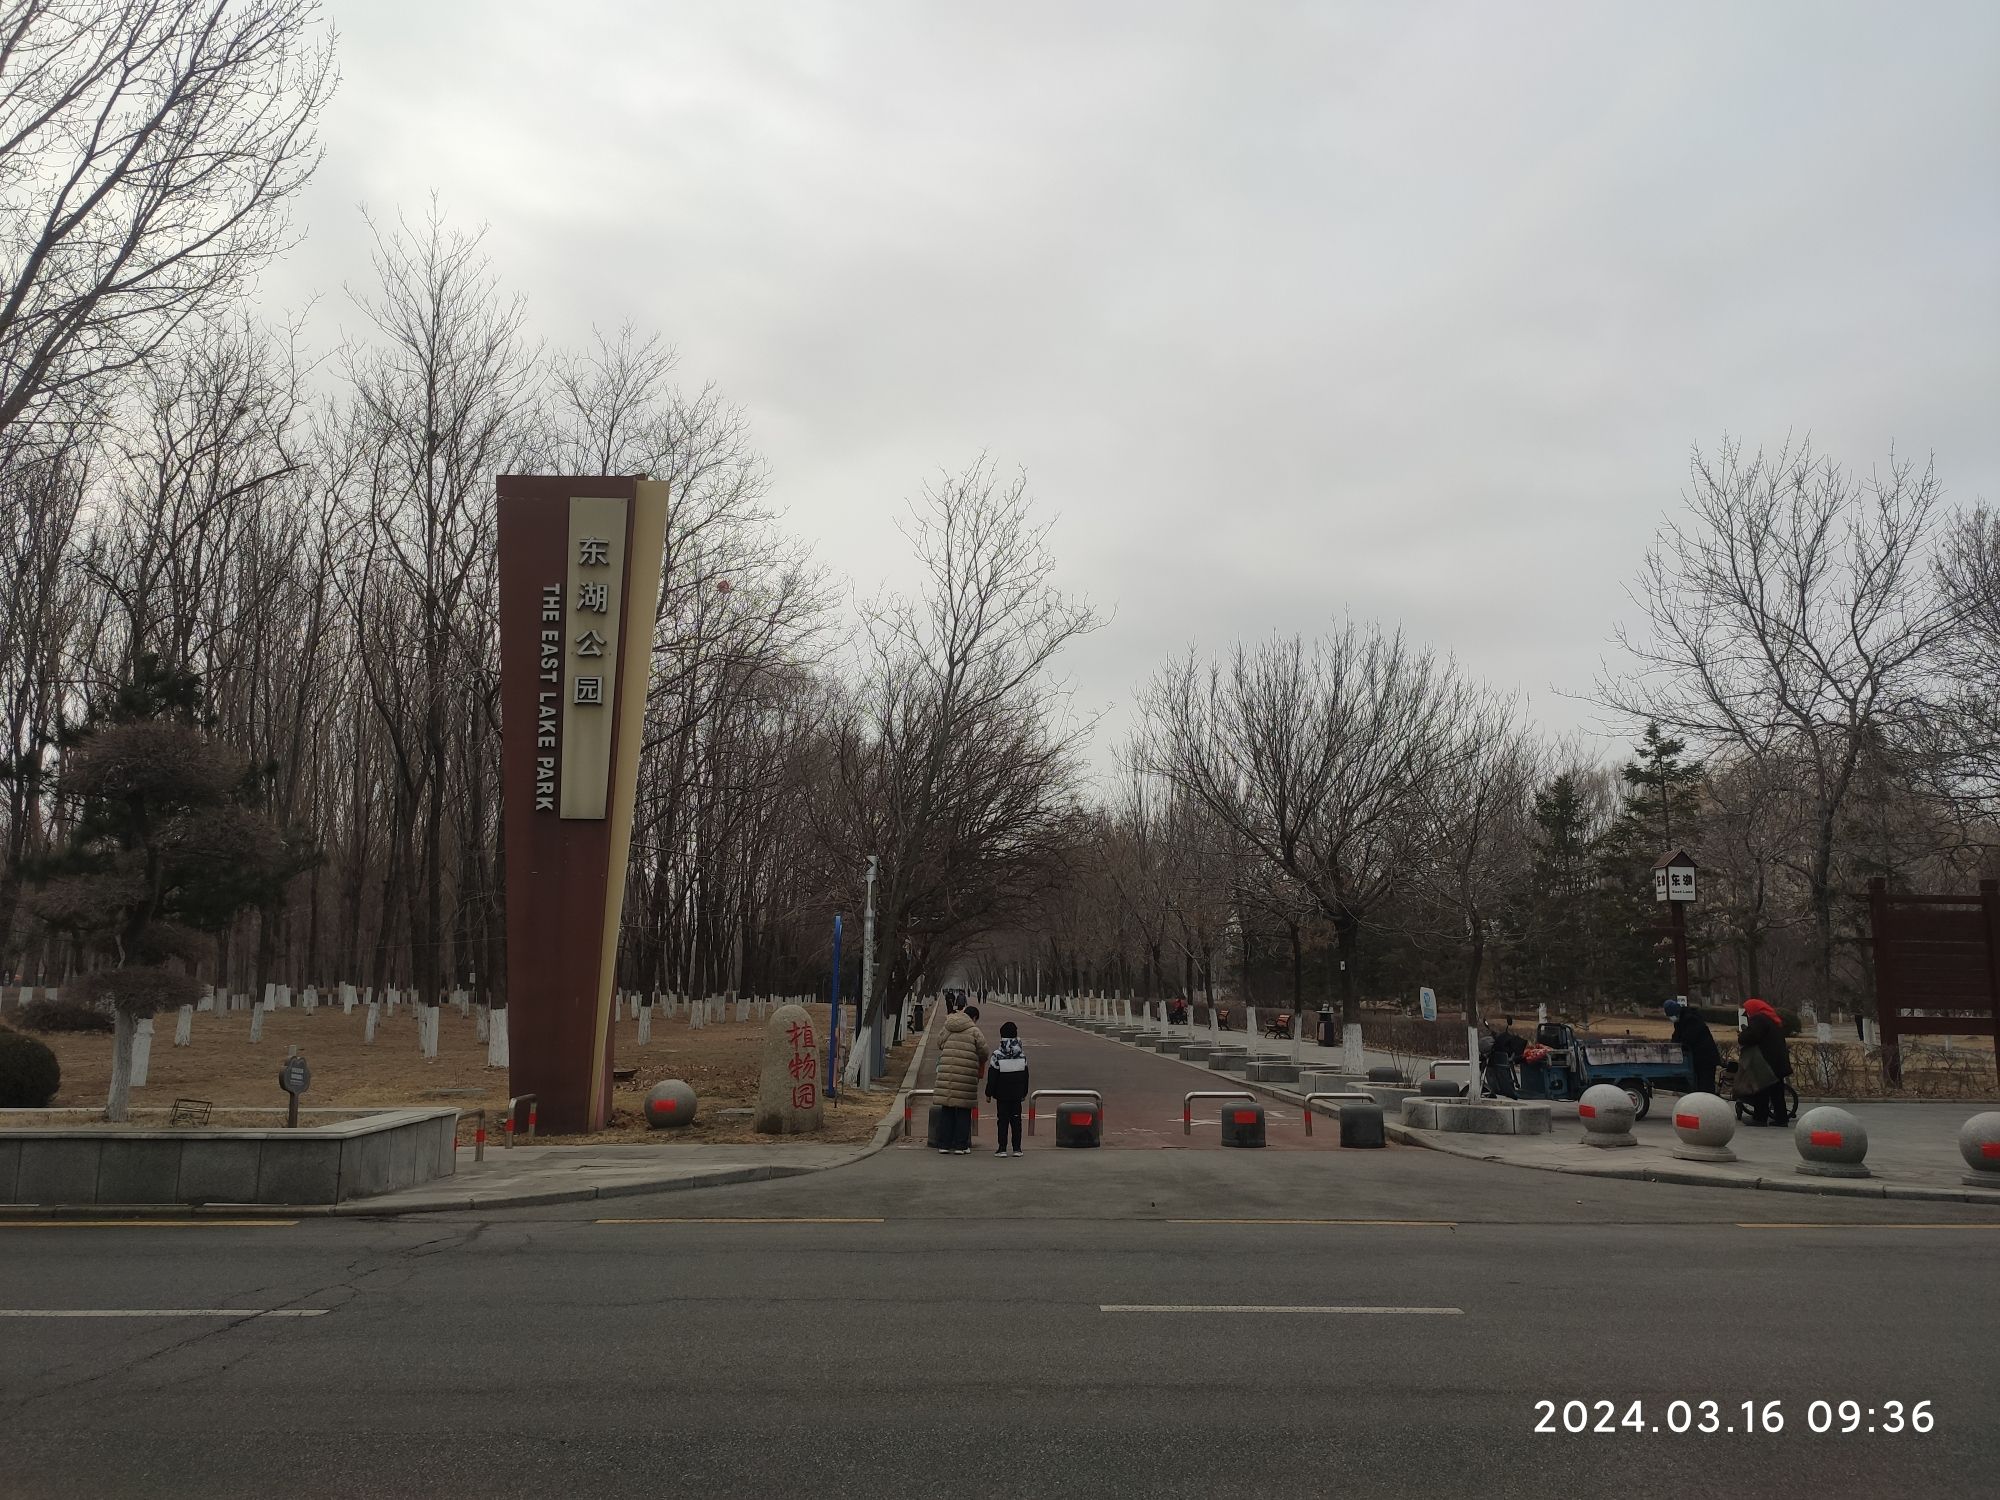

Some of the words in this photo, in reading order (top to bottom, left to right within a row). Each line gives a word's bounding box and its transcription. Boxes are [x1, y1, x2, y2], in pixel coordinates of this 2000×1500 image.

[542, 583, 560, 621] THE
[573, 535, 609, 706] 东湖公园
[540, 630, 559, 683] EAST
[537, 692, 557, 747] LAKE
[535, 757, 555, 811] PARK
[786, 1021, 816, 1110] 植物园
